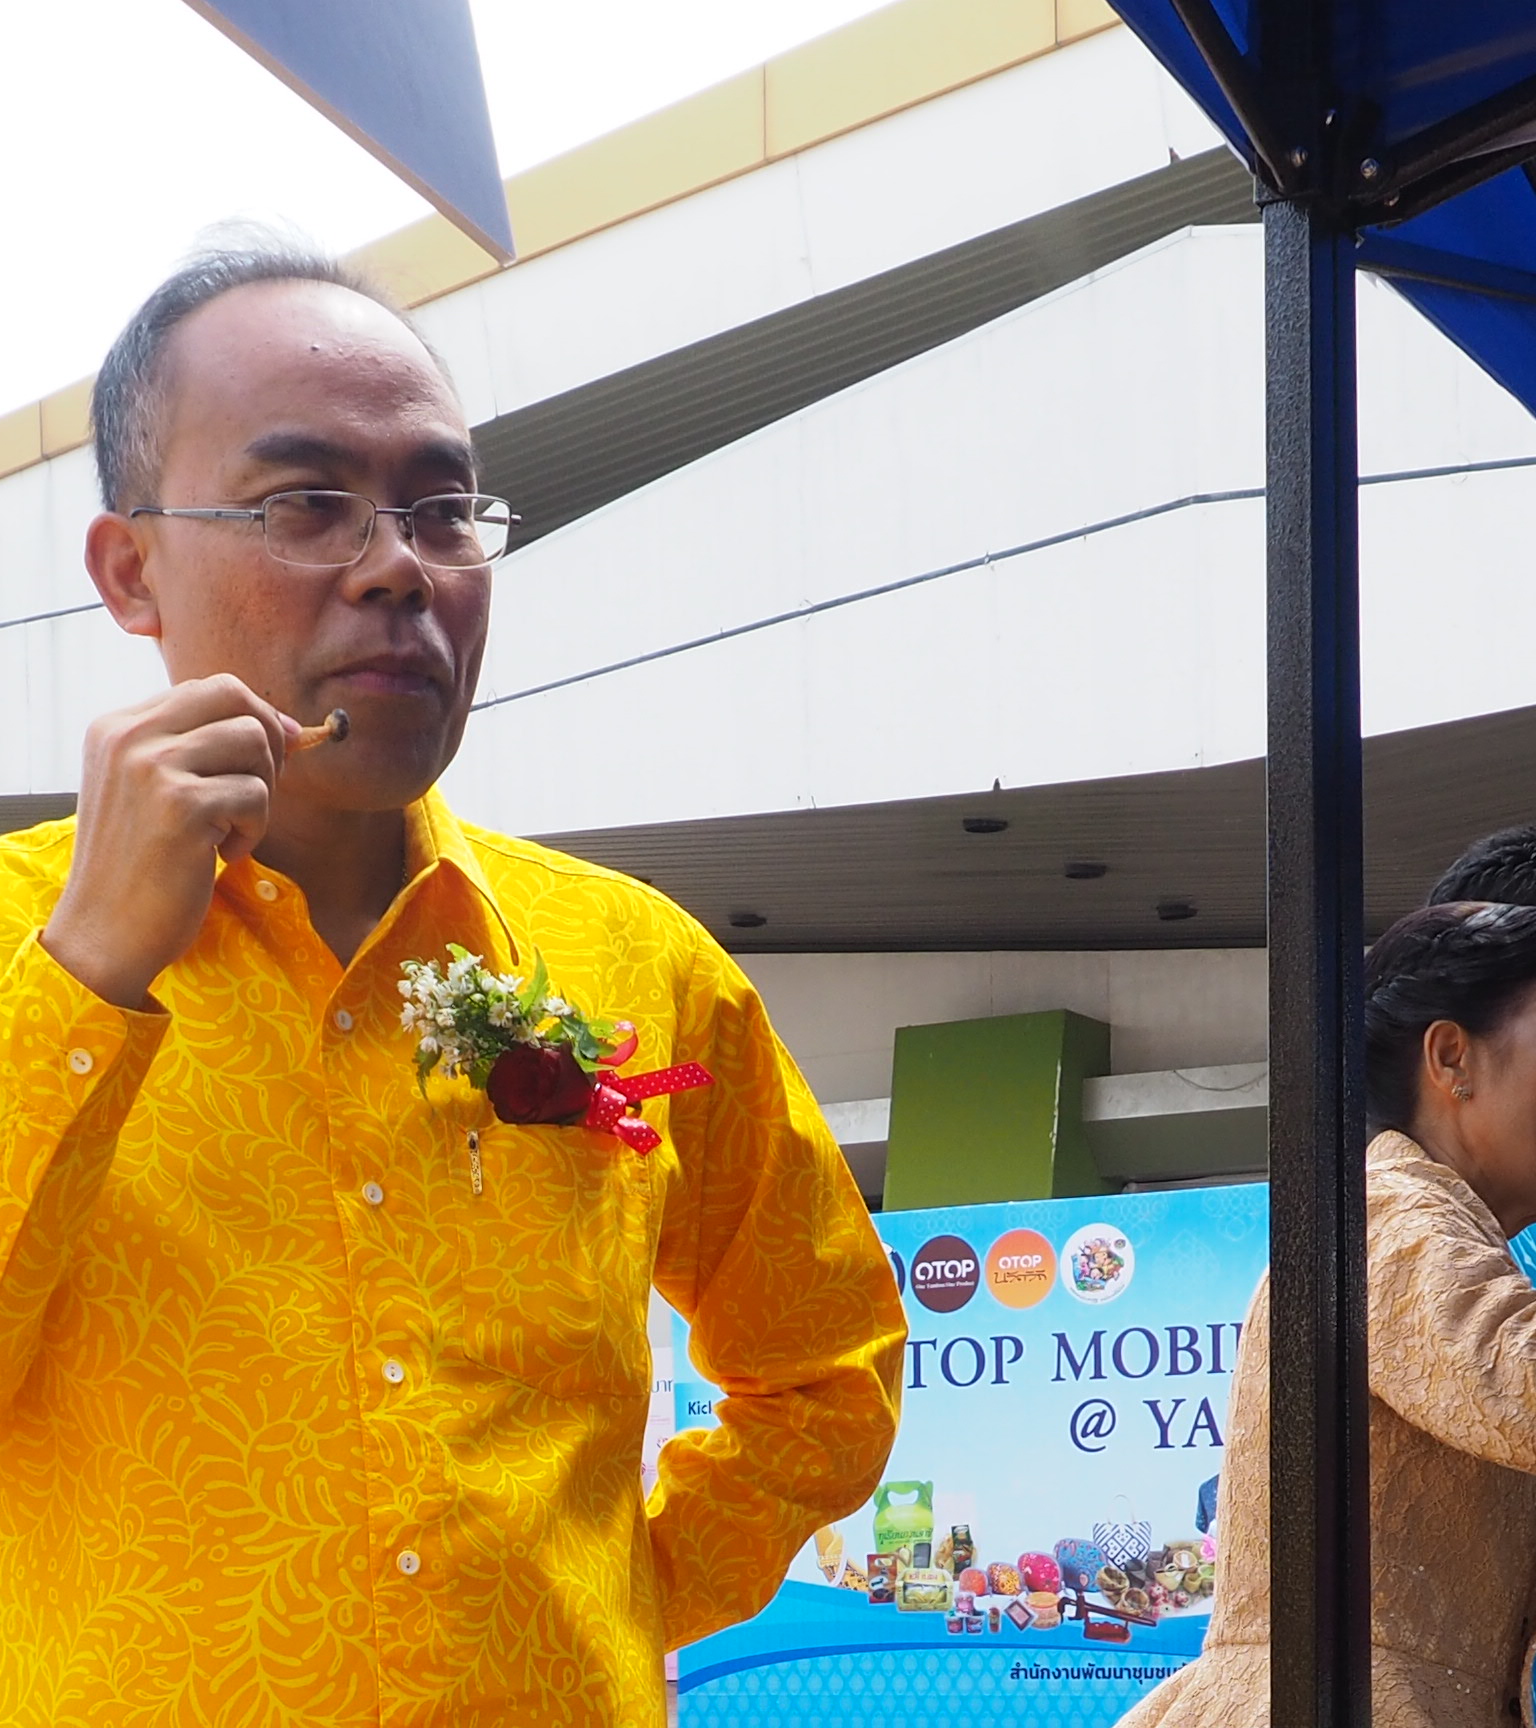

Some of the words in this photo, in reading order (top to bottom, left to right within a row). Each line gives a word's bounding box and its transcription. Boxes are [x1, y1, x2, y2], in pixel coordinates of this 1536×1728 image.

[915, 1259, 975, 1281] OTOP
[999, 1254, 1042, 1269] OTOP
[1070, 1398, 1117, 1453] @
